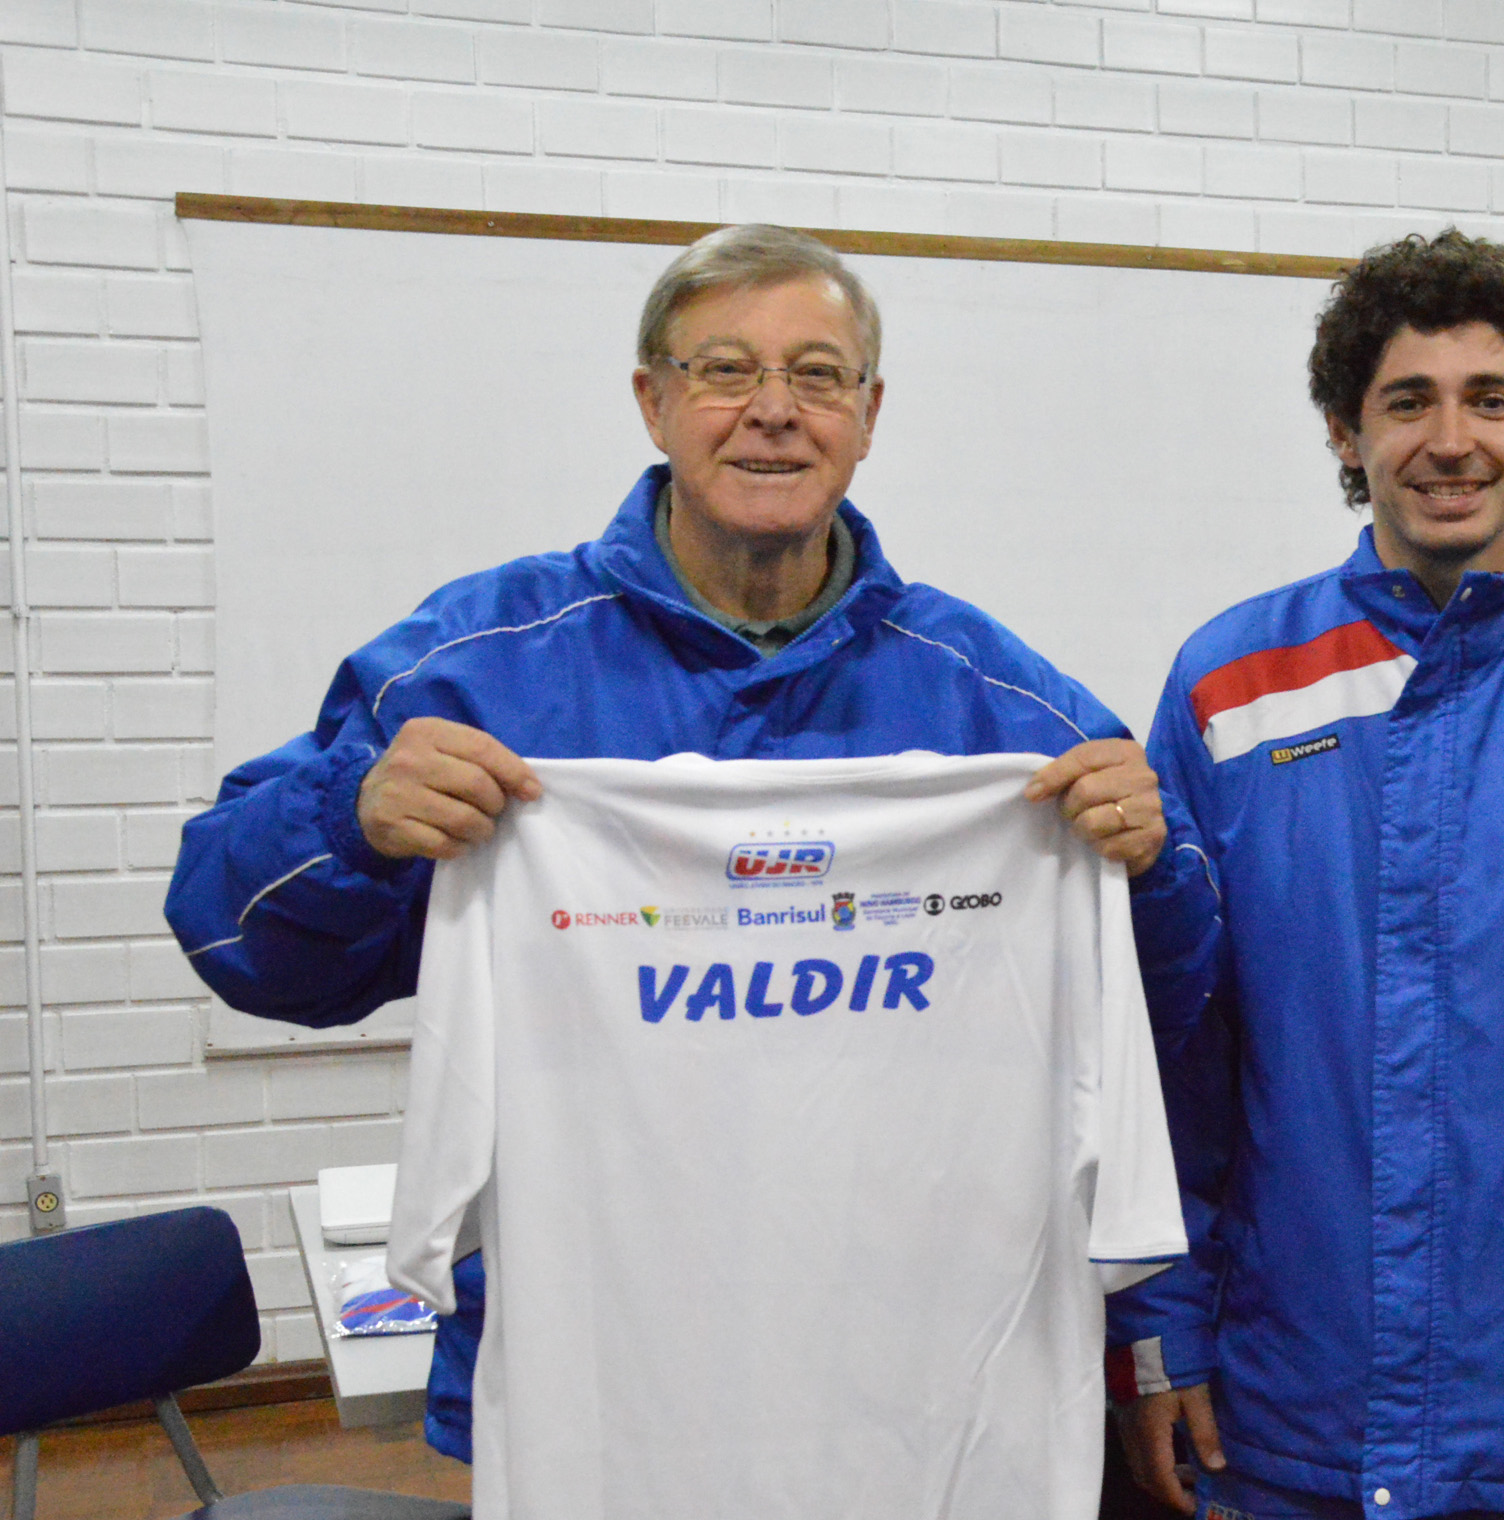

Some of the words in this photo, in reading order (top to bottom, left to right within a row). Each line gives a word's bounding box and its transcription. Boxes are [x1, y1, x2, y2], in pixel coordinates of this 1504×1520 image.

[735, 848, 825, 876] UJR
[949, 891, 1003, 911] GLOBO
[576, 912, 638, 926] RENNER
[664, 913, 728, 926] FEEVALE
[738, 904, 826, 927] Banrisul
[638, 951, 934, 1024] VALDIR
